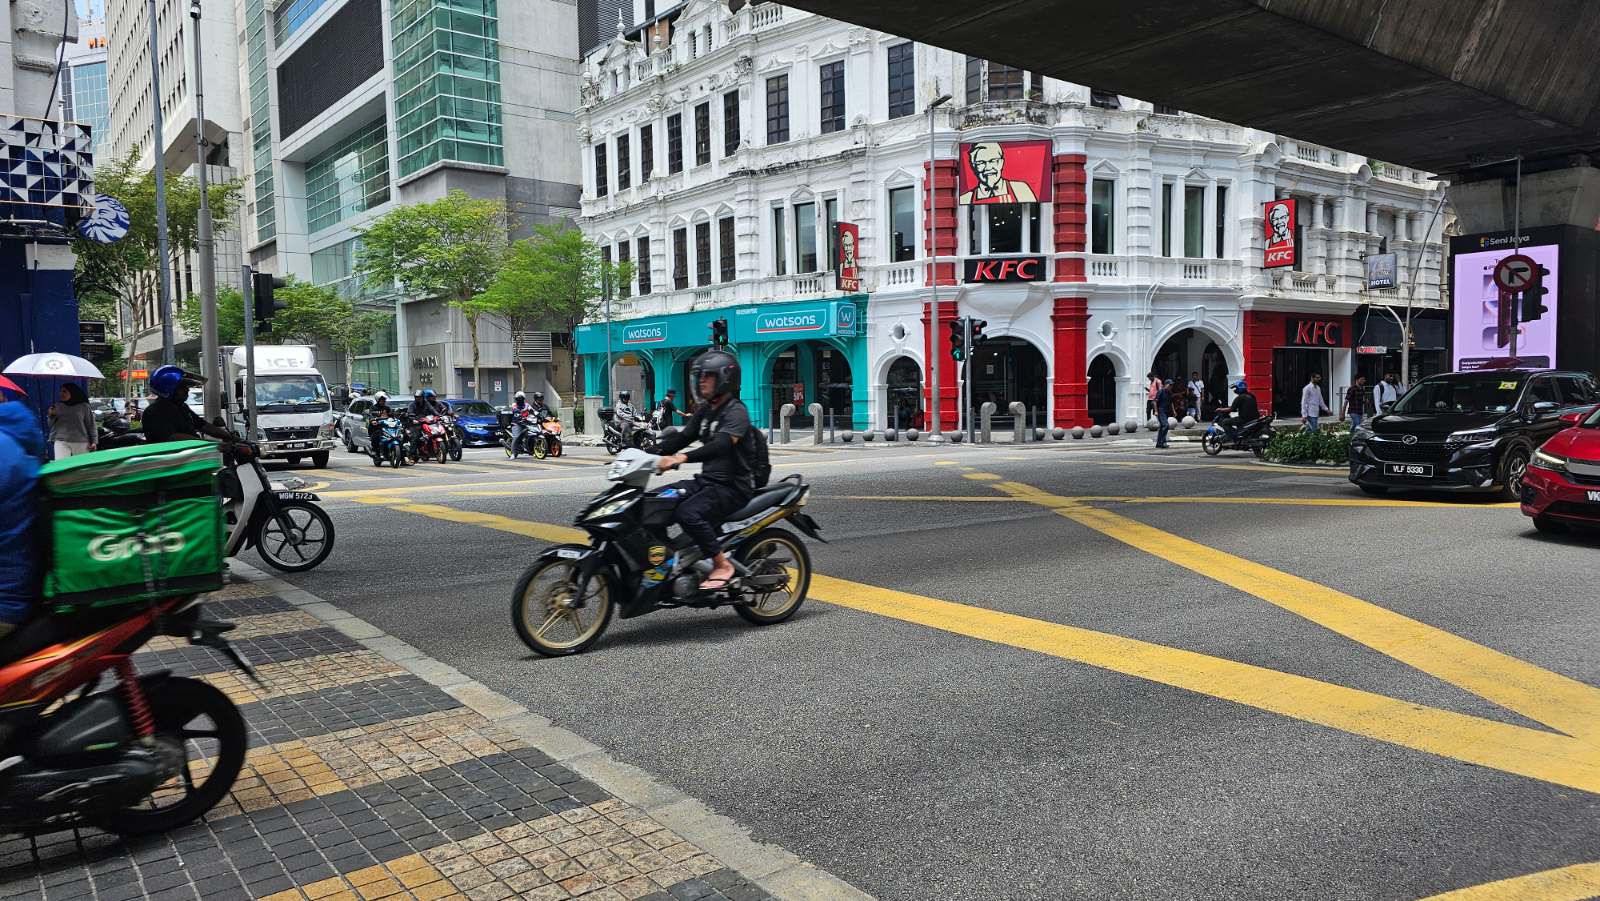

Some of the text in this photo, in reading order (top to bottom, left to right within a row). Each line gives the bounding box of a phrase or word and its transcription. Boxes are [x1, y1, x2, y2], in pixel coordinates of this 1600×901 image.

[1268, 251, 1292, 262] KFC
[974, 260, 1038, 280] KFC
[841, 280, 857, 289] KFC
[765, 315, 816, 328] watsons
[628, 328, 661, 339] watsons
[1297, 320, 1337, 345] KFC
[1392, 465, 1405, 473] VLF
